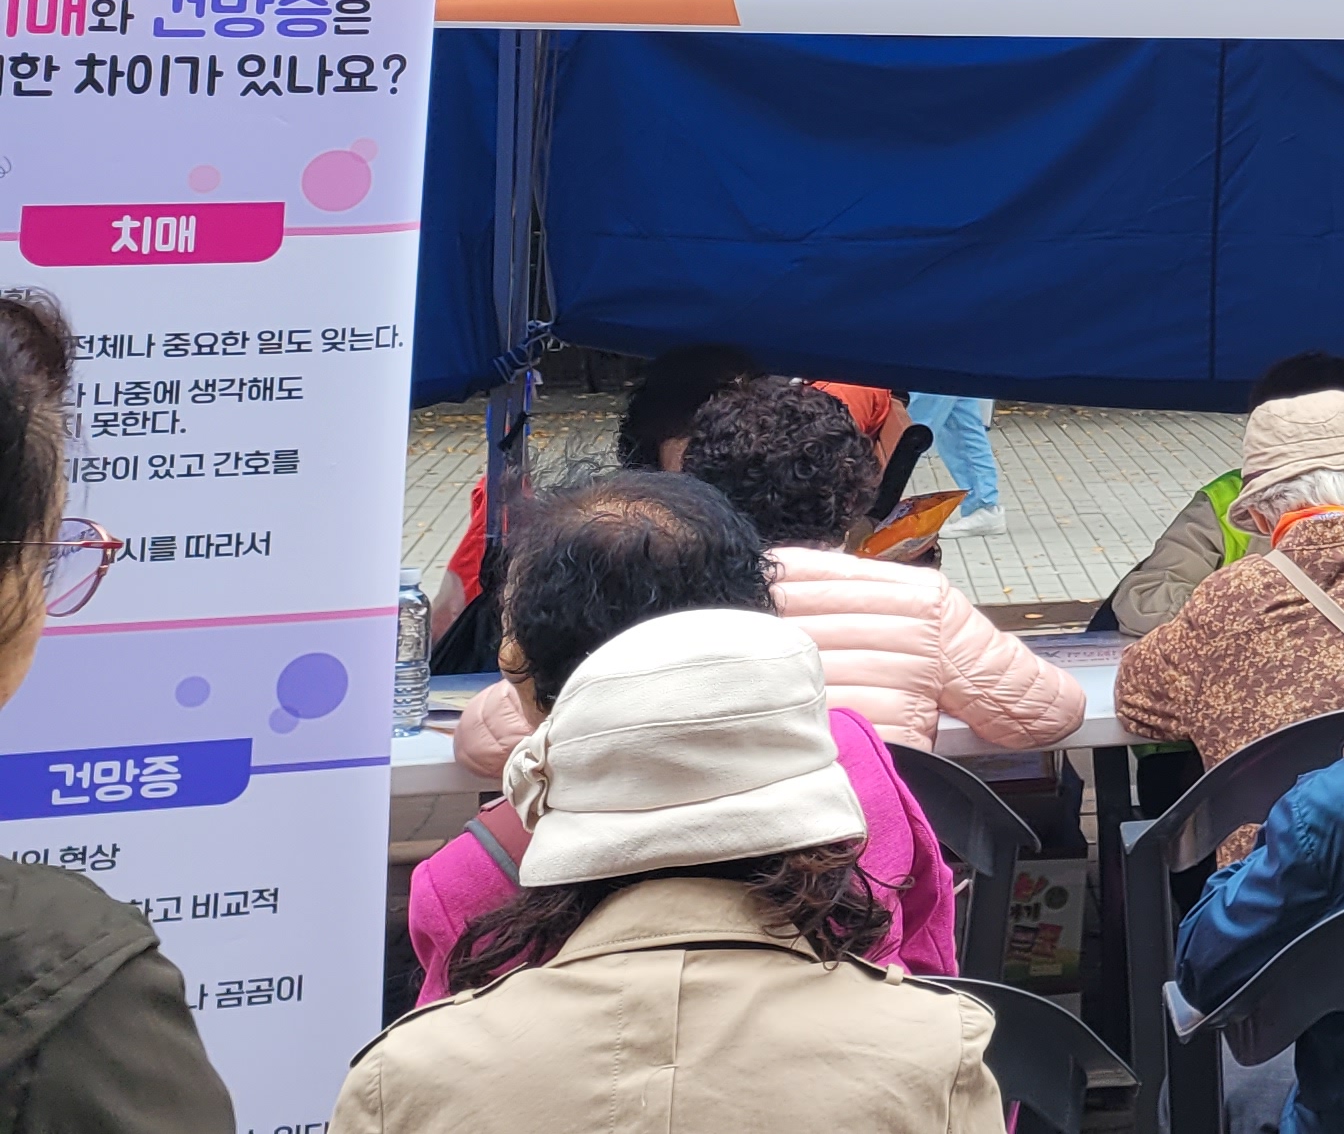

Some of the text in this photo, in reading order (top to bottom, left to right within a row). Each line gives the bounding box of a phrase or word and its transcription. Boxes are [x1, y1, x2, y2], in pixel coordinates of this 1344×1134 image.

[0, 53, 408, 98] 한 차이가 있나요?
[111, 214, 197, 255] 치매
[71, 325, 404, 361] 전체나 중요한 일도 잊는다.
[93, 379, 181, 408] 나중에
[188, 376, 304, 404] 생각해도
[90, 409, 187, 439] 못한다.
[148, 453, 205, 481] 있고
[213, 449, 301, 479] 간호를
[112, 531, 272, 564] 시를 따라서
[48, 755, 182, 806] 건망증
[59, 843, 121, 873] 현상
[191, 887, 280, 921] 비교적
[215, 974, 304, 1010] 곰곰이
